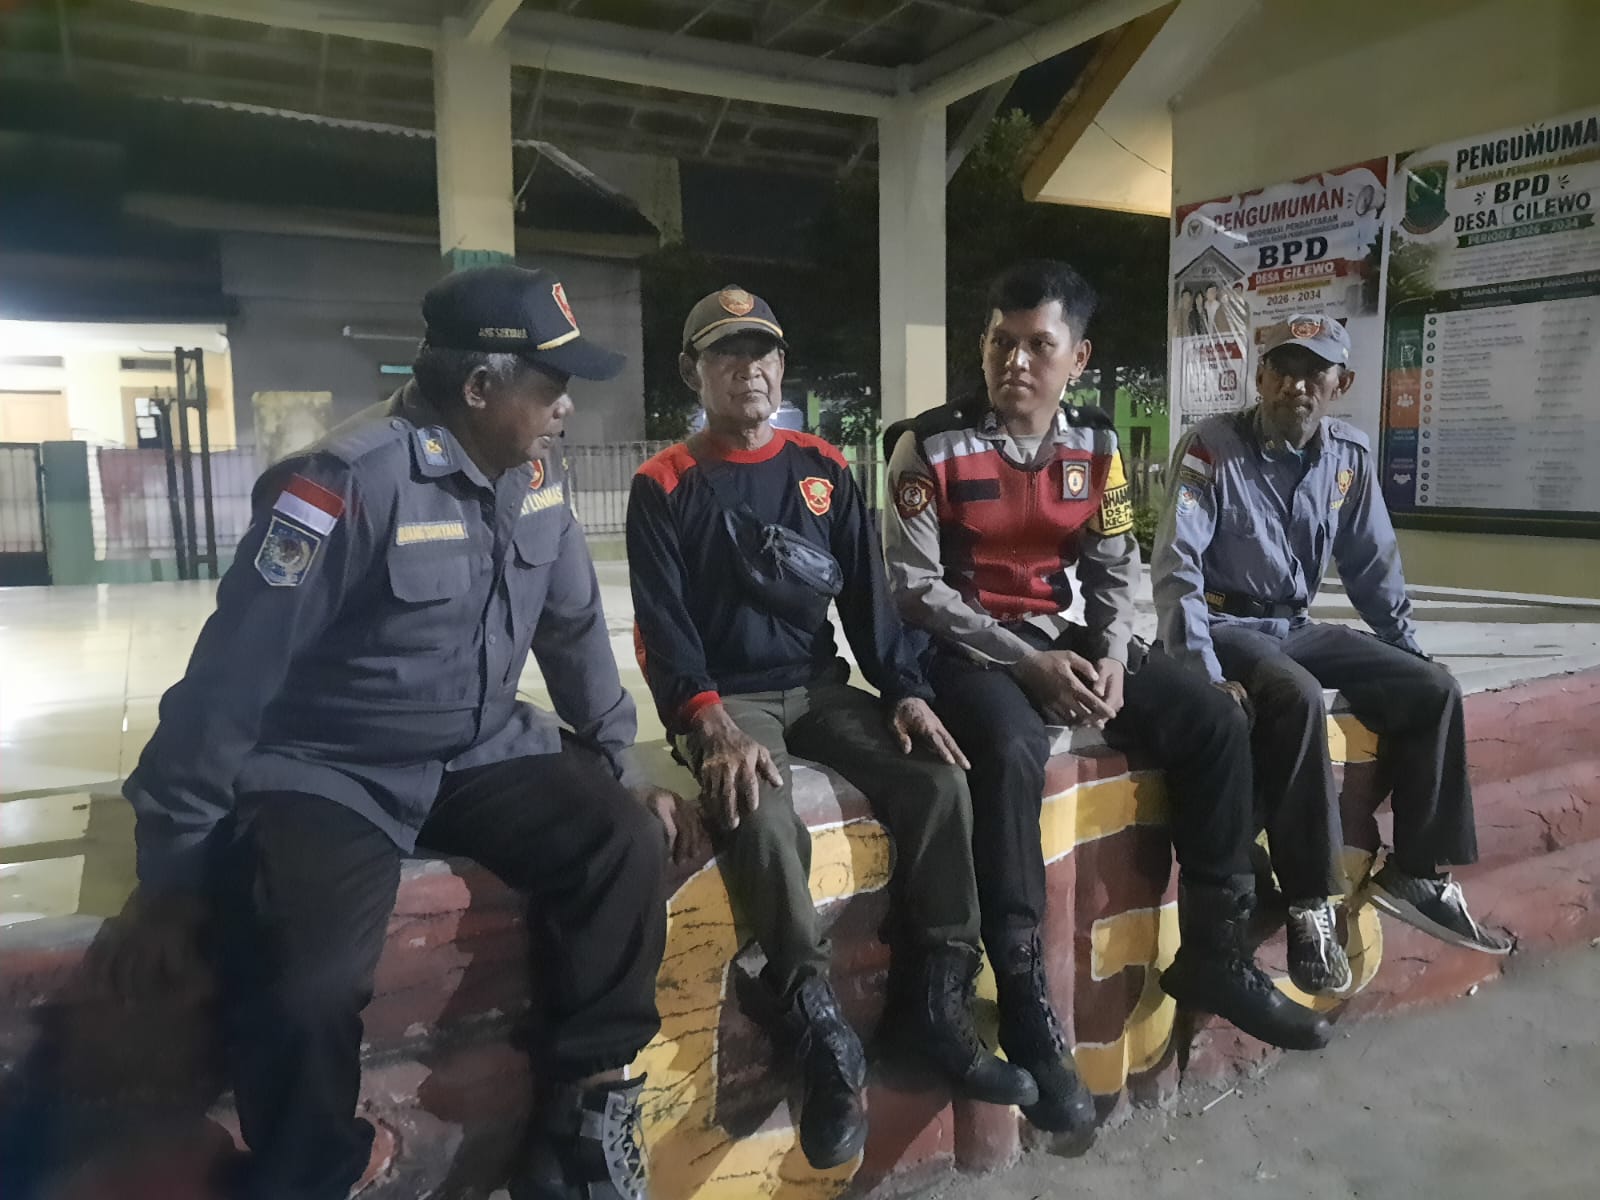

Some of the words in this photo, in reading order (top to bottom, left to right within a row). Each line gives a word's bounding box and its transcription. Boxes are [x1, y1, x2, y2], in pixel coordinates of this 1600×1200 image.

[1456, 117, 1597, 173] PENGUMUMA
[1494, 174, 1550, 204] BPD
[1213, 187, 1345, 234] PENGUMUMAN
[1454, 209, 1498, 233] DESA
[1513, 192, 1591, 223] CILEWO
[1258, 236, 1329, 269] BPD
[1256, 271, 1280, 286] DESA
[1283, 261, 1335, 283] CILEWO
[1298, 290, 1321, 301] 2034
